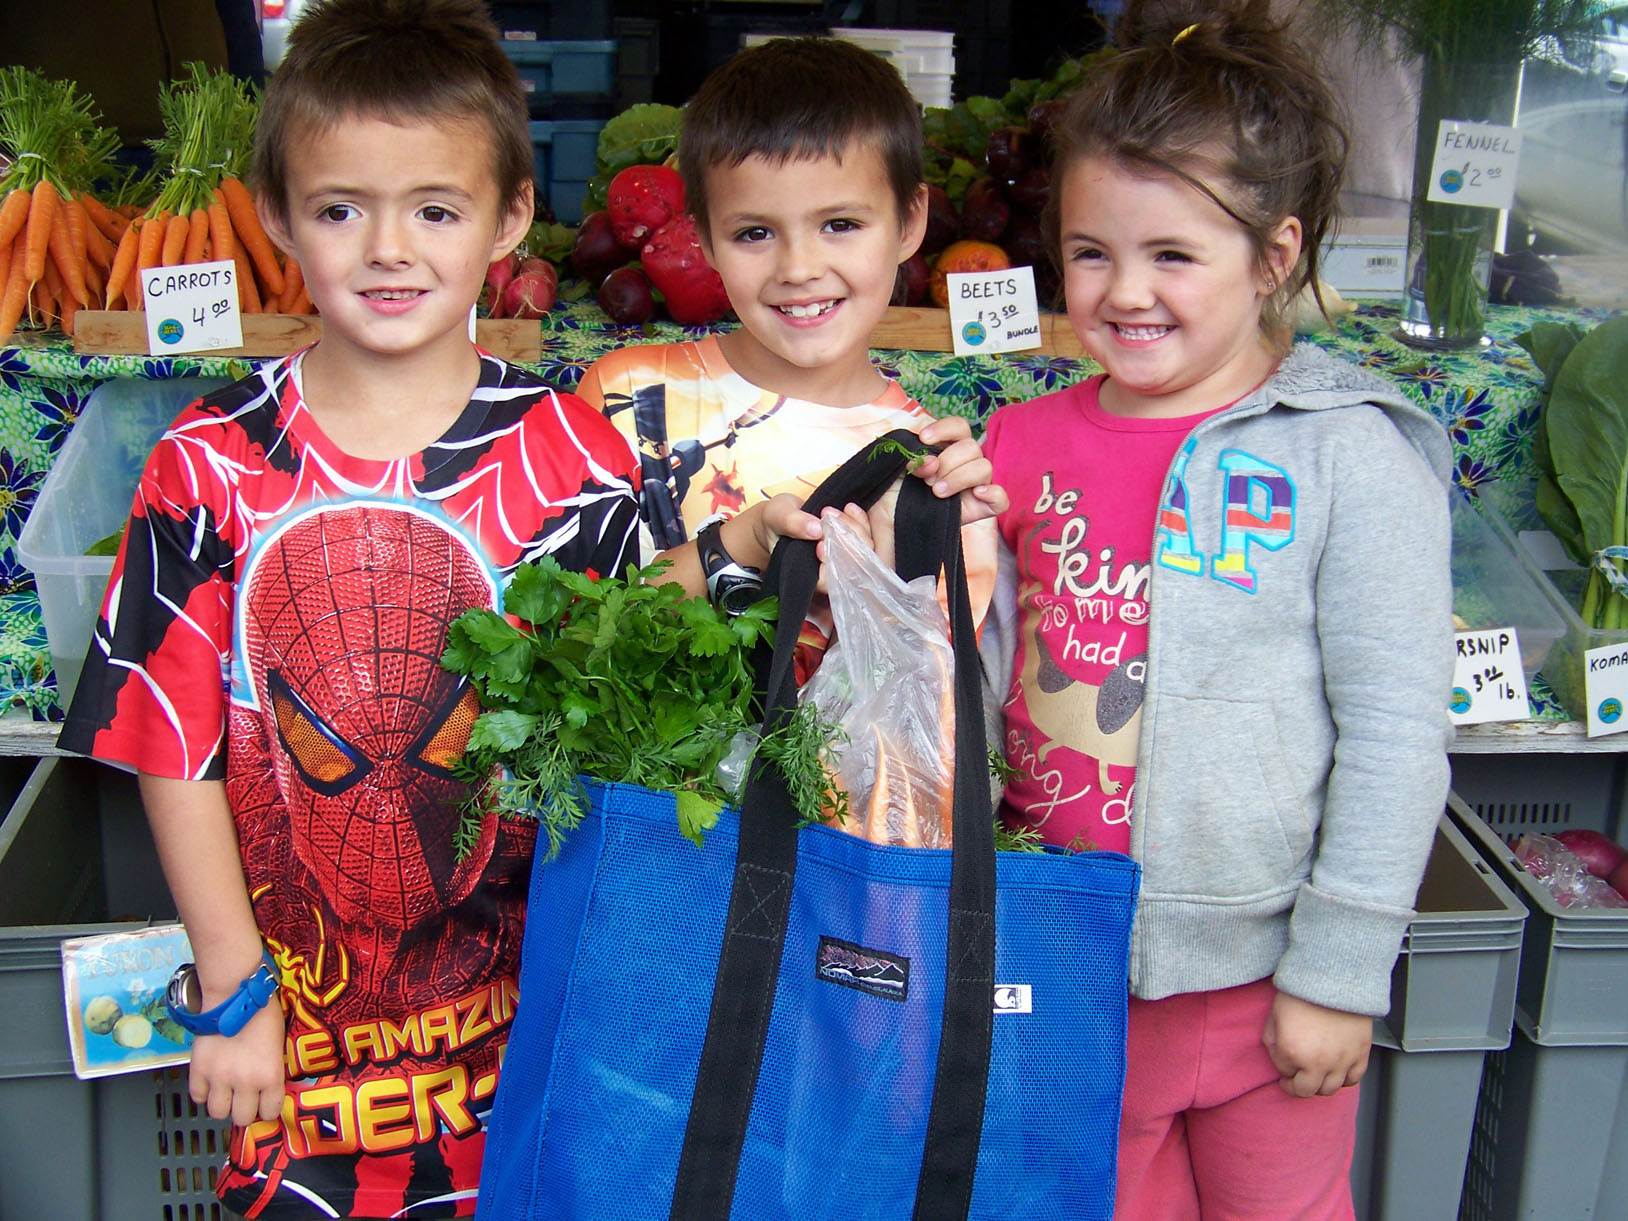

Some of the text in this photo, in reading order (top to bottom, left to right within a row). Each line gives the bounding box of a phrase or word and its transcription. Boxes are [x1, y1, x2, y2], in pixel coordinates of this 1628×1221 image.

[1444, 132, 1515, 154] FENNEL
[148, 270, 232, 297] CARROTS
[961, 278, 1017, 299] BEETS
[1006, 324, 1039, 340] BUNDLE
[1033, 471, 1083, 516] be
[1035, 595, 1150, 632] to me
[1063, 624, 1127, 667] had
